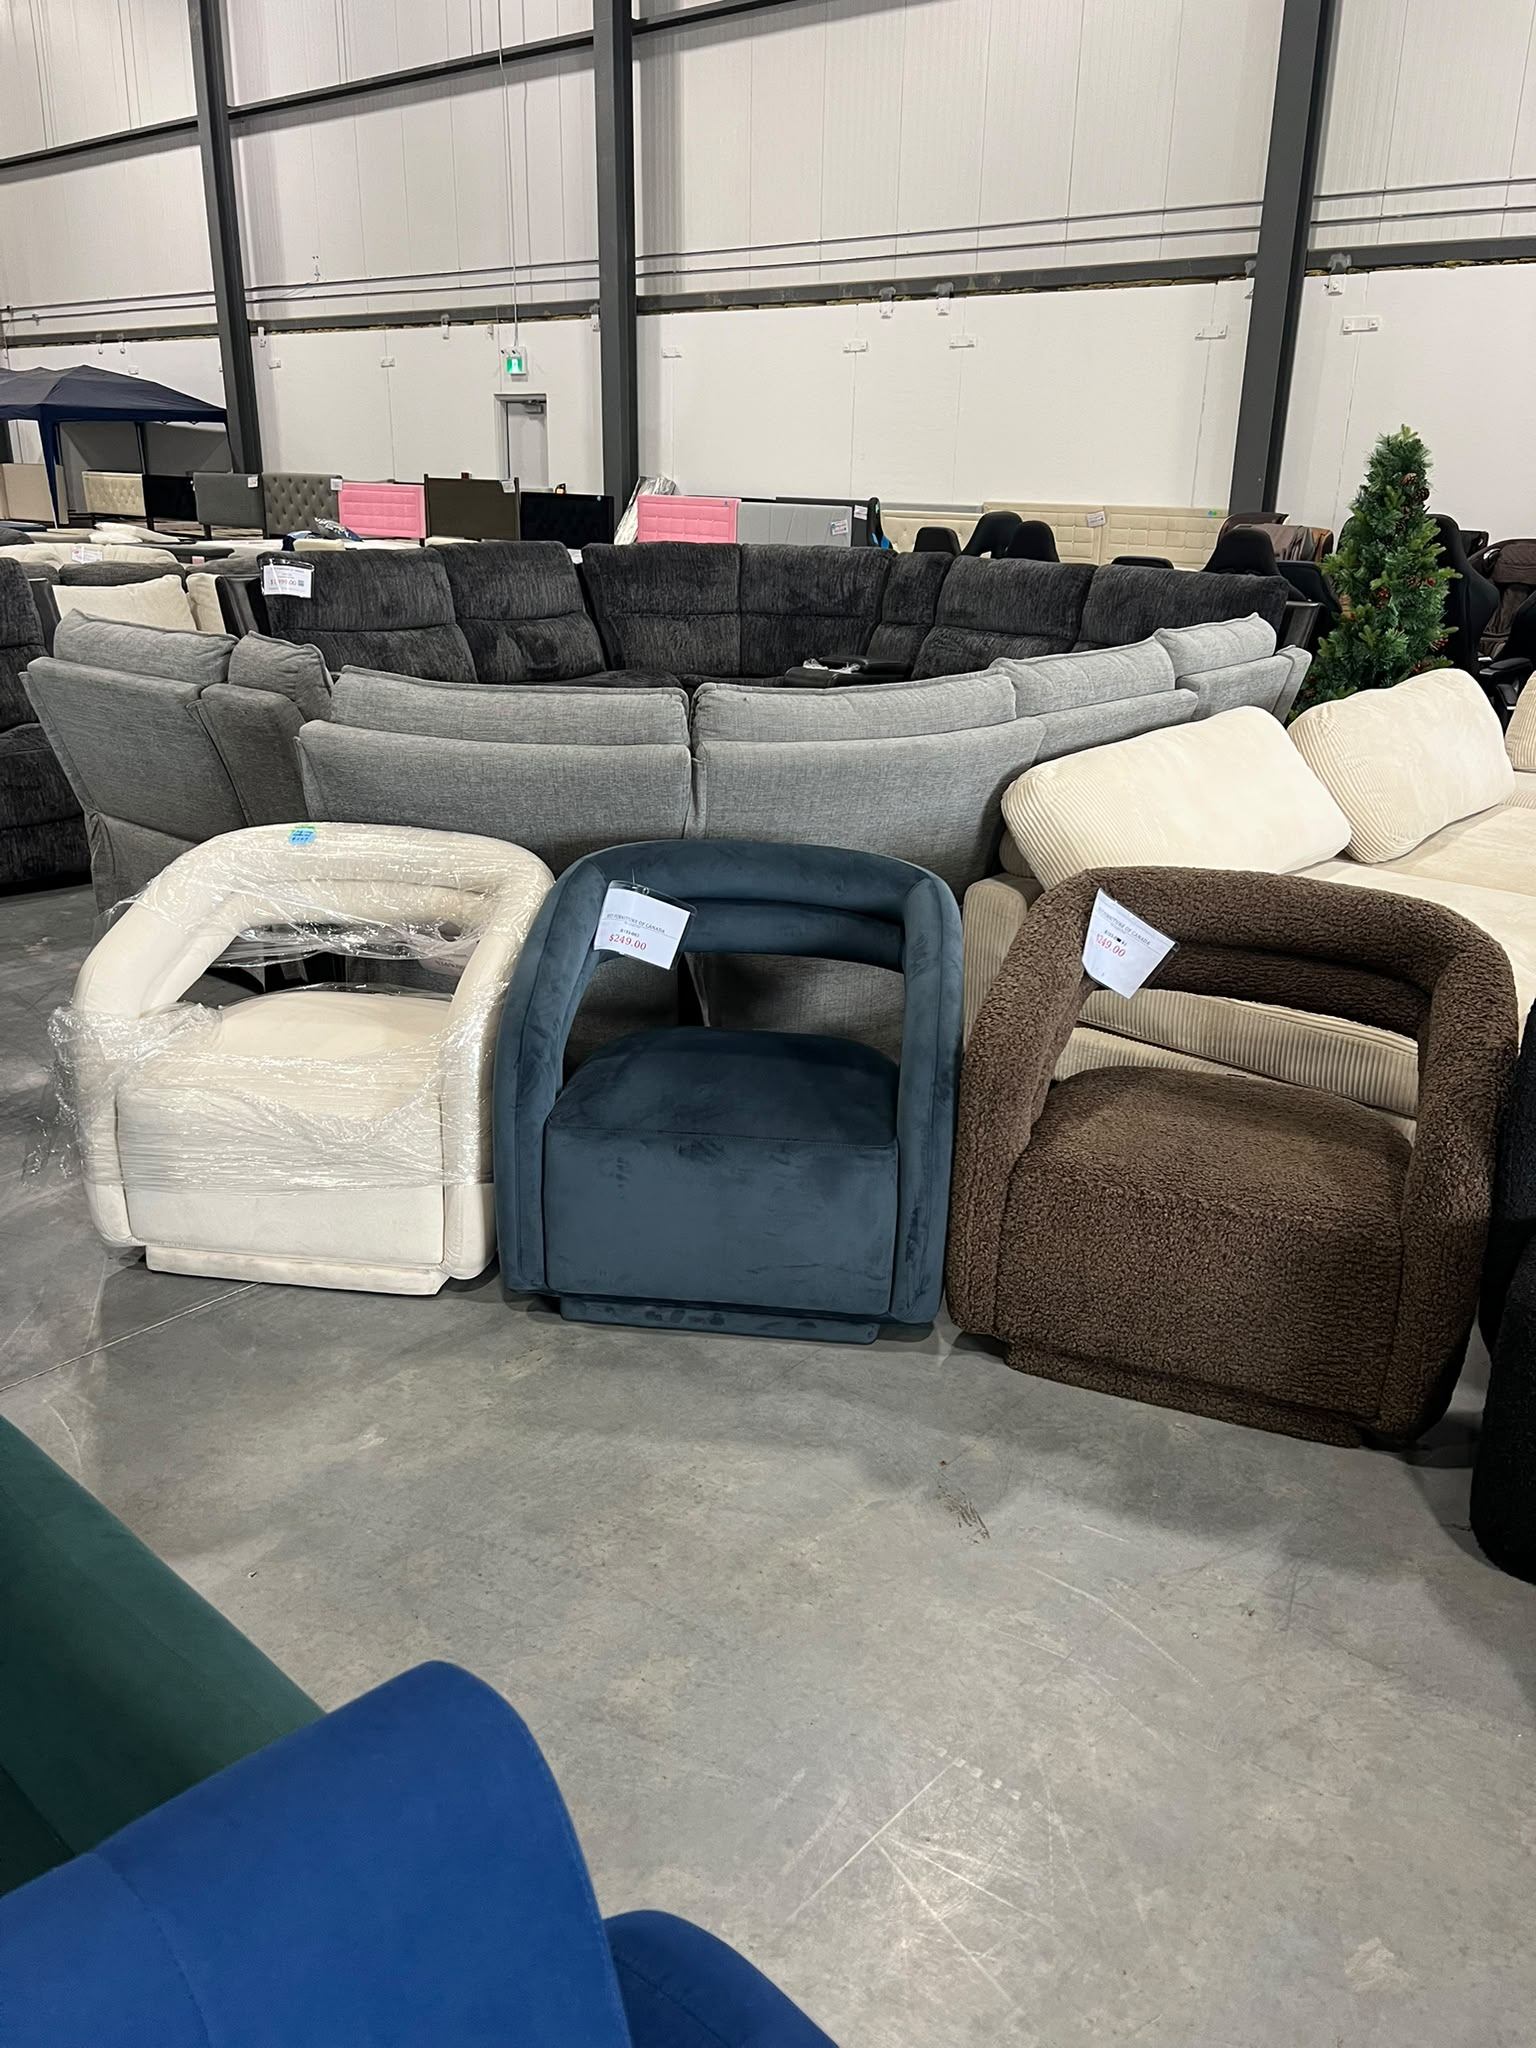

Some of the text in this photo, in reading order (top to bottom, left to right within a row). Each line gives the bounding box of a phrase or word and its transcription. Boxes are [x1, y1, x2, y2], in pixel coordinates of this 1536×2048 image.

[645, 922, 665, 933] CANADA
[609, 933, 647, 950] $249.00
[1132, 930, 1150, 945] CANADA
